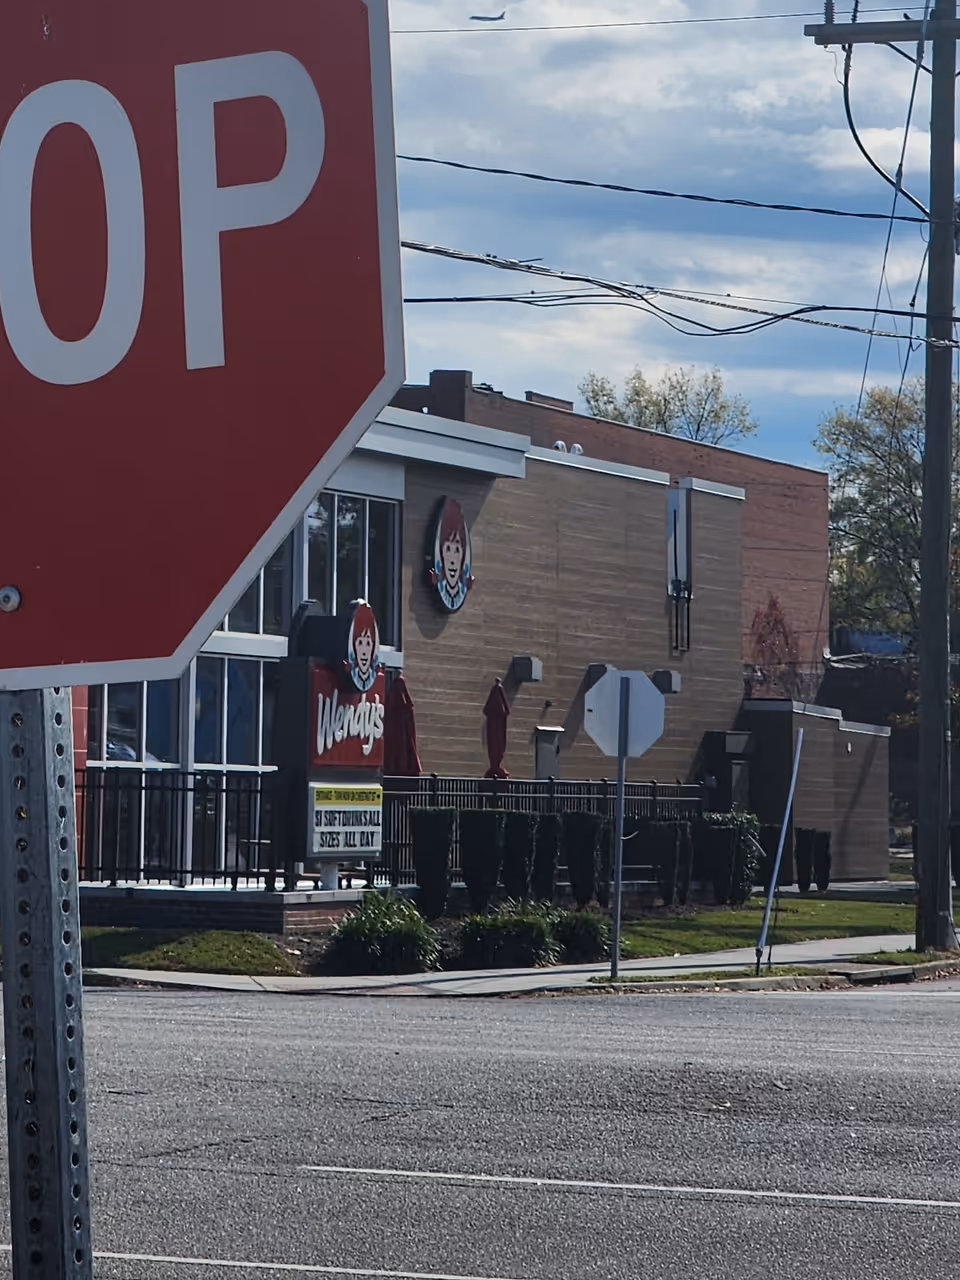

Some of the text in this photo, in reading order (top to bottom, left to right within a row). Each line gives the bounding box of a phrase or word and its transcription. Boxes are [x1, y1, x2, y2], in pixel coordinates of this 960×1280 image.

[316, 688, 385, 756] Wendy's
[319, 830, 375, 848] SIZES ALL DAY
